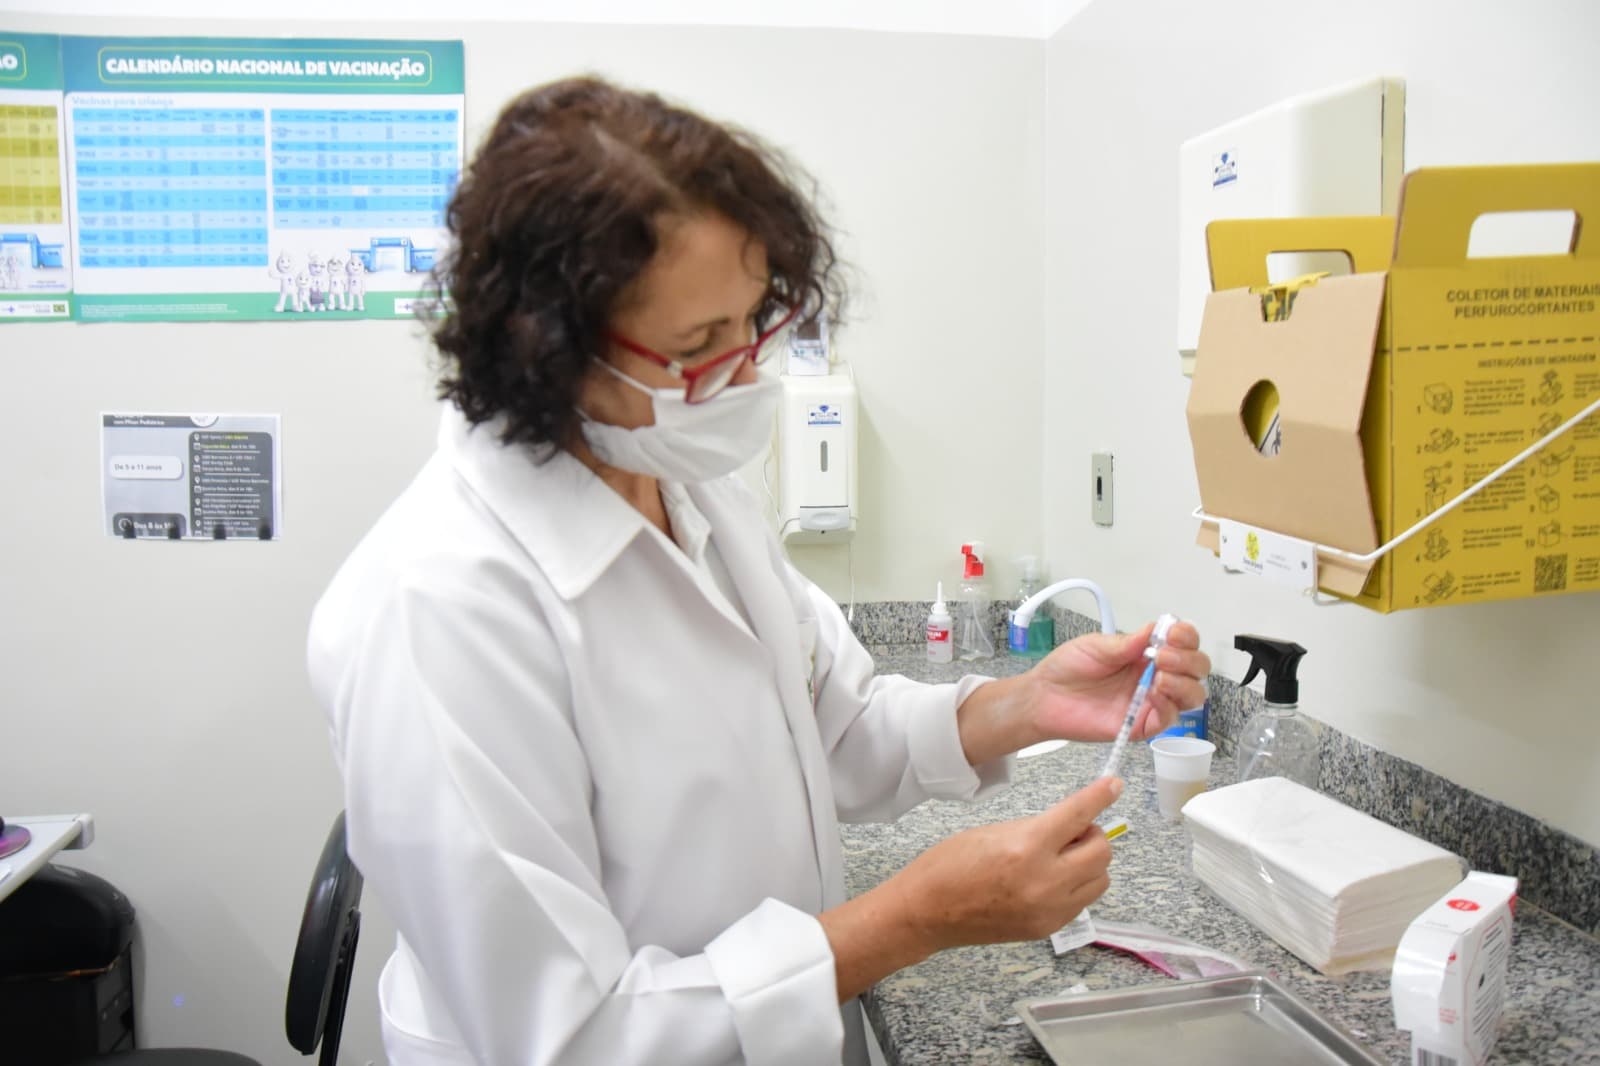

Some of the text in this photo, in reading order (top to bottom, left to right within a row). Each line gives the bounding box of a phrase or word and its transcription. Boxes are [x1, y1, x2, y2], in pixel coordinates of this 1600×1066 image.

[0, 54, 18, 70] O
[106, 55, 425, 80] CALENDÁRIO NACIONAL DE VACINAÇÃO
[72, 96, 111, 105] Vacinas
[113, 97, 136, 109] para
[1446, 284, 1600, 302] COLETOR DE MATERIAIS
[1454, 301, 1594, 318] PERFUROCORTANTES
[1478, 356, 1532, 368] INSTRUÇÕES
[1548, 353, 1596, 364] MONTAGEM
[114, 463, 124, 471] De
[137, 463, 144, 471] 11
